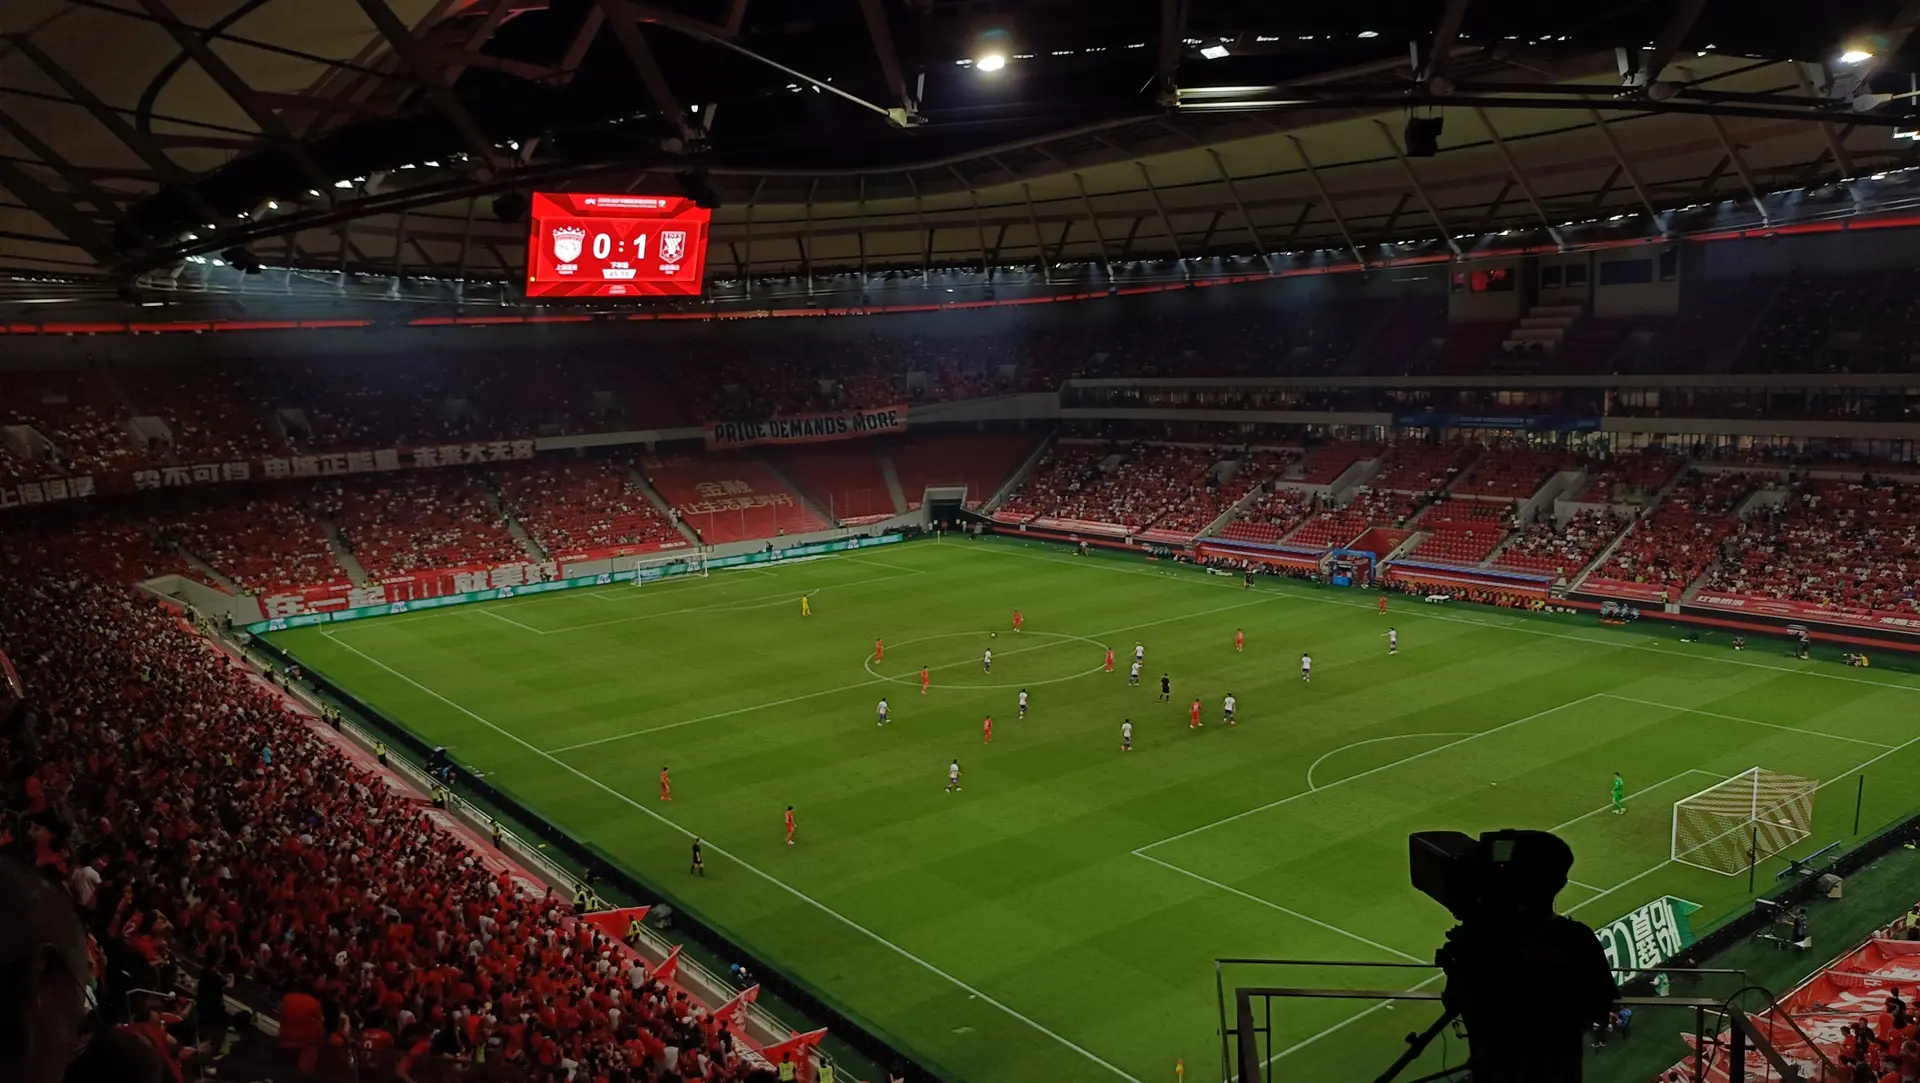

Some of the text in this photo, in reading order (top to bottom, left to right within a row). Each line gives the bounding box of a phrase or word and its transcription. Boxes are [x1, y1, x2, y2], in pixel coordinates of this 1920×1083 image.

[593, 233, 611, 260] 0
[633, 233, 647, 259] 1
[715, 410, 899, 443] PRIDE DEMANDS MORE
[132, 462, 251, 491] 势不可挡
[695, 479, 754, 498] 金融
[1802, 608, 1840, 617] SHANGHAI
